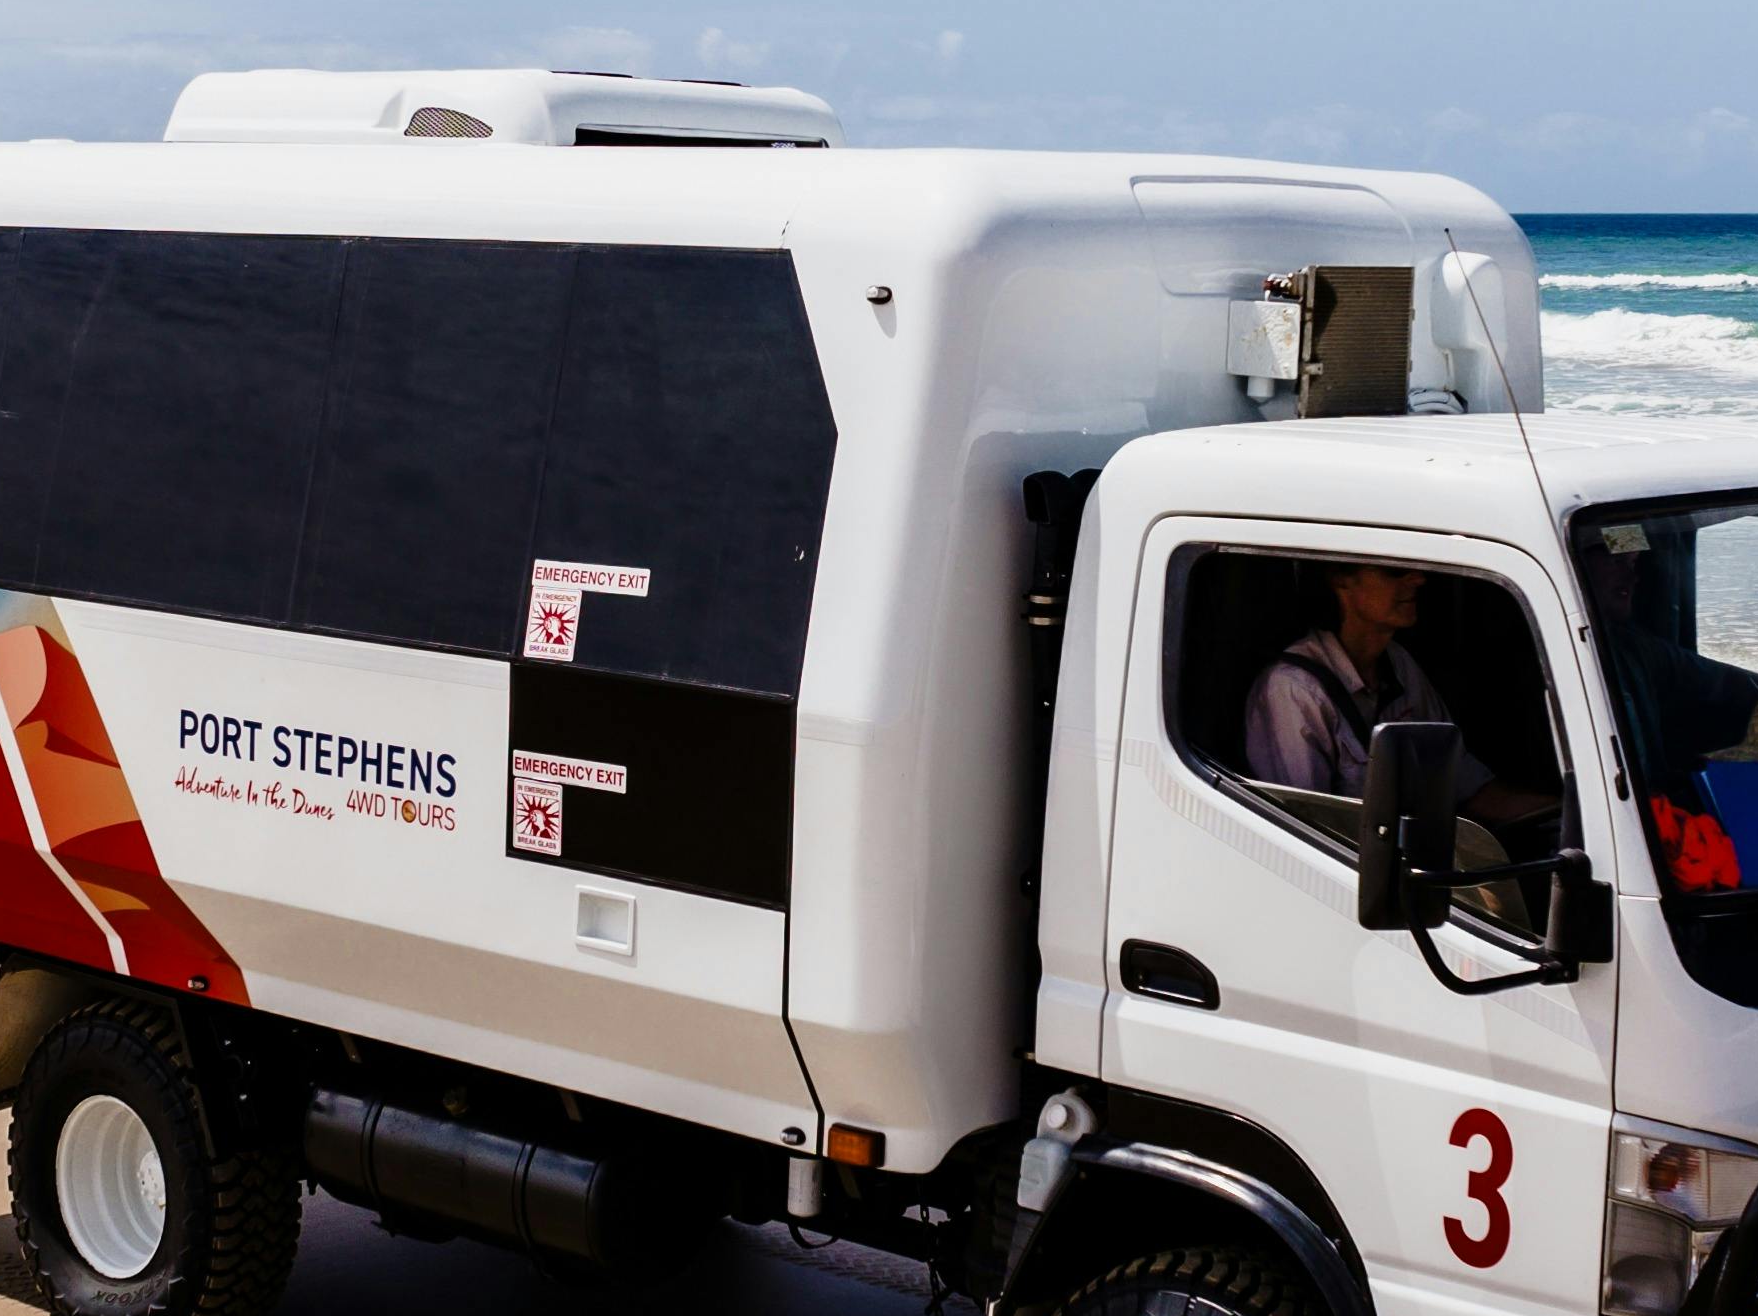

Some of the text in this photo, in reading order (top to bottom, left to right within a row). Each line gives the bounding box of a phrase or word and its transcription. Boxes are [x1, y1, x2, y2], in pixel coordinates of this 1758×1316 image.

[534, 566, 647, 590] EMERGENCY EXIT
[179, 709, 457, 798] PORT STEPHENS
[514, 756, 625, 787] EMERGENCY EXIT
[174, 765, 336, 821] Adventure In the Dunes
[345, 788, 456, 832] 4WD TOURS
[1443, 1107, 1513, 1269] 3
